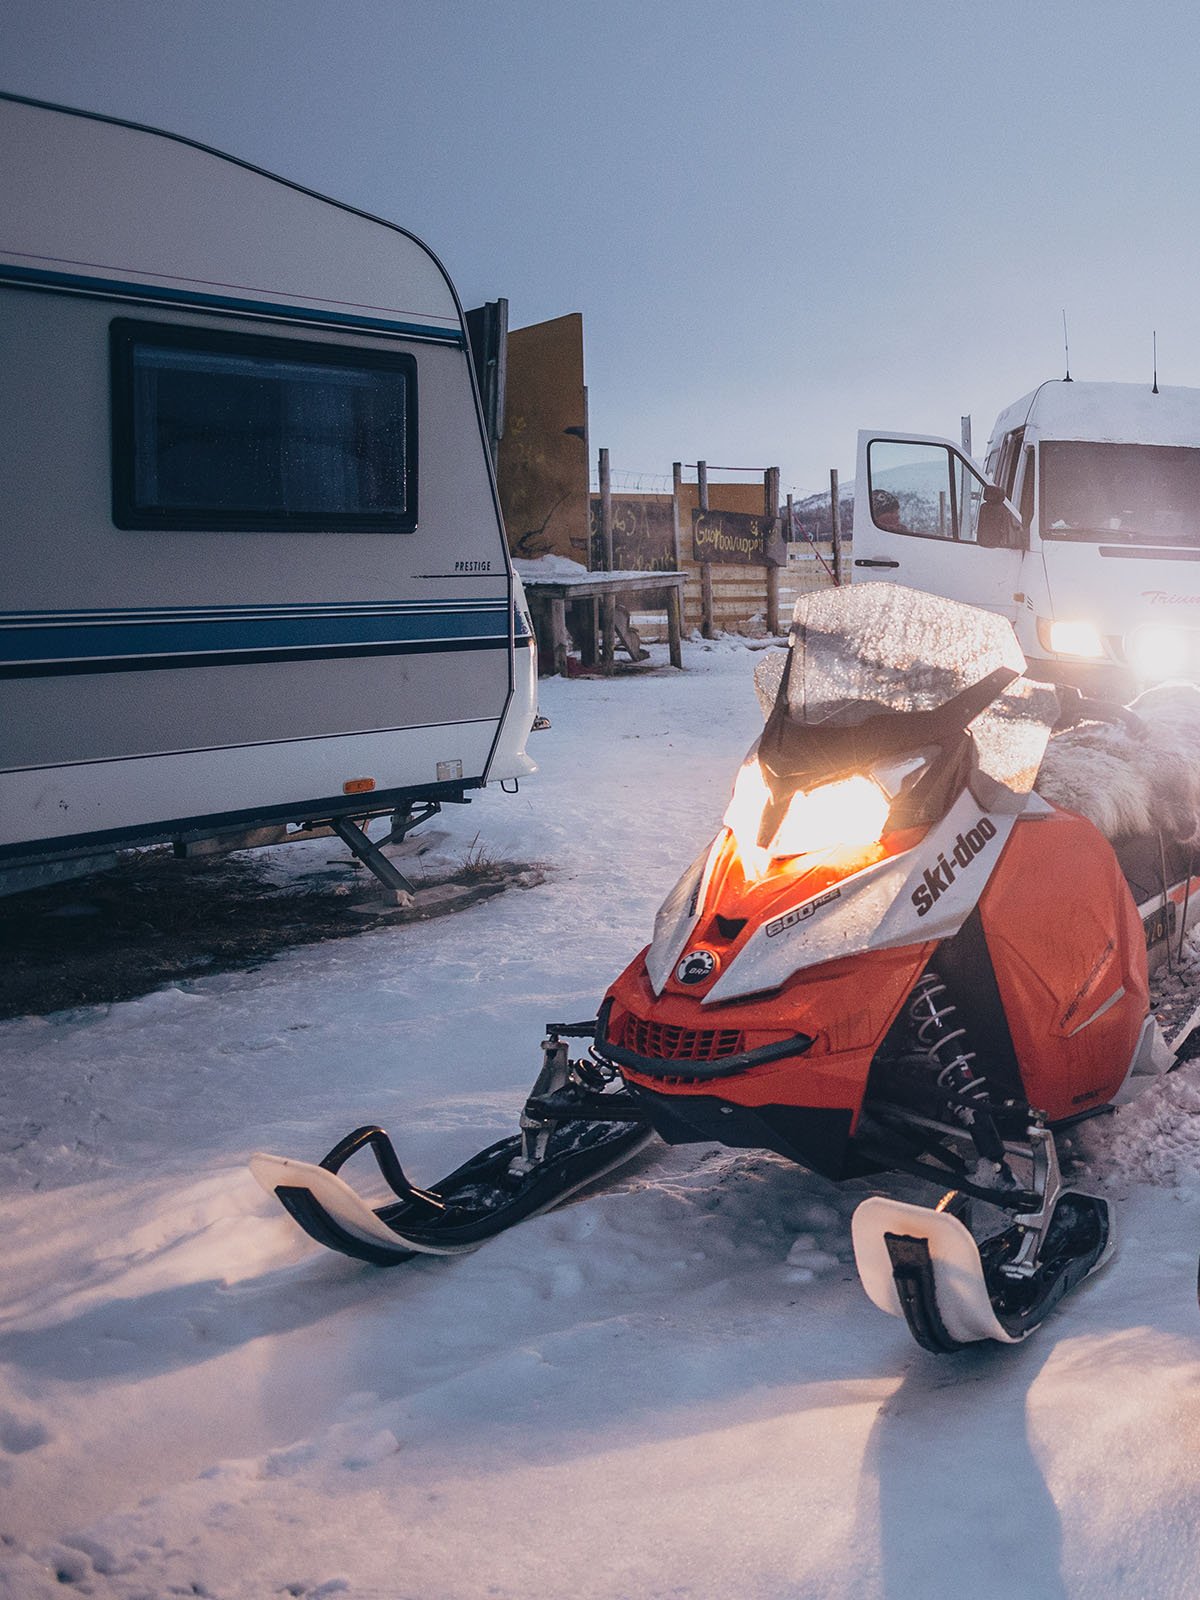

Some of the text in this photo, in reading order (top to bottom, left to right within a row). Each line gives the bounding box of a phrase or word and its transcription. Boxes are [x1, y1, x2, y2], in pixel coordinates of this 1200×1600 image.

[454, 561, 491, 571] PRESTIGE
[766, 901, 815, 938] 600
[689, 967, 710, 975] BRP
